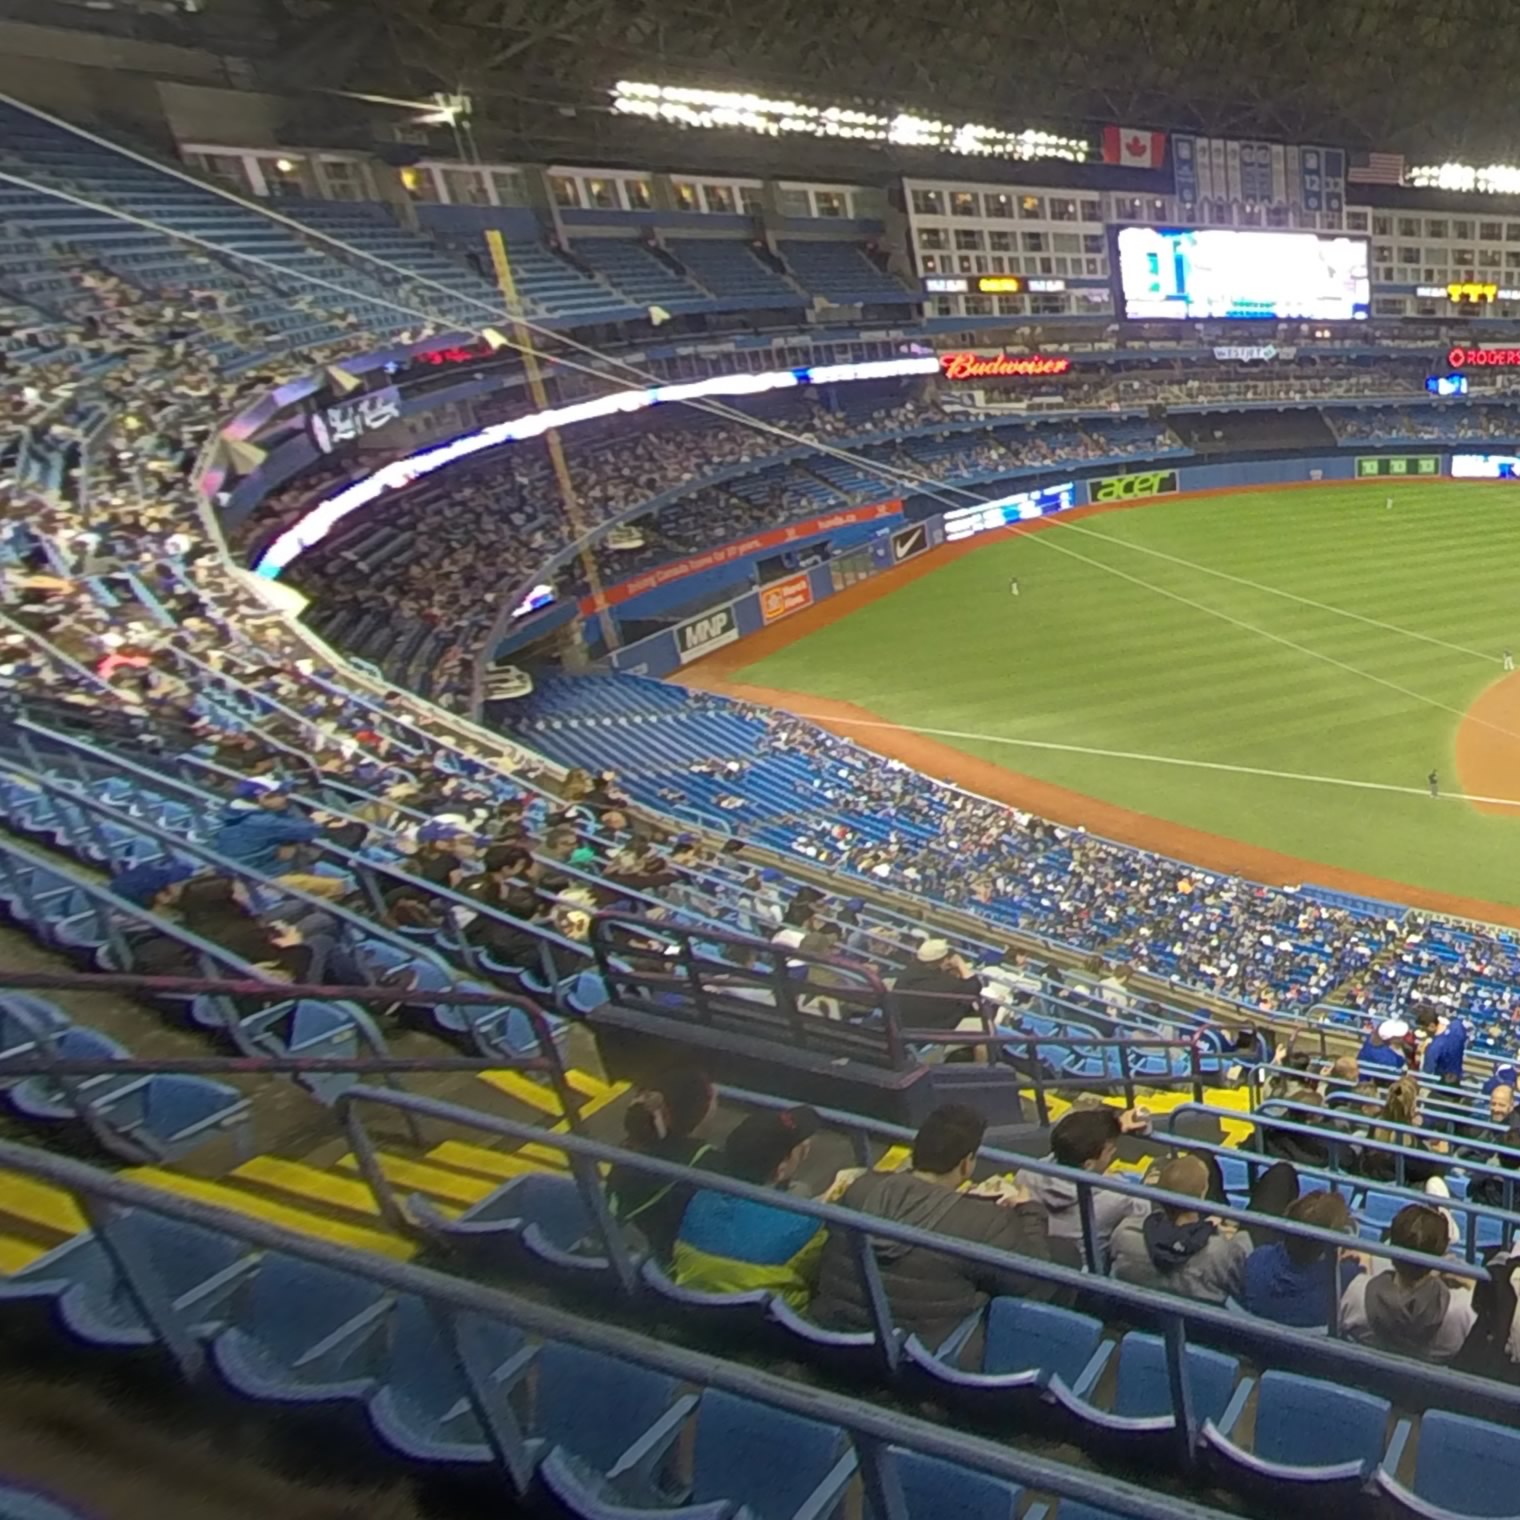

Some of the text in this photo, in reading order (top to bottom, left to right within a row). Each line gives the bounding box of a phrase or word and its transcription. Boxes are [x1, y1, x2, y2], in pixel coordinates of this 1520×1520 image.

[1304, 175, 1320, 191] 12
[940, 352, 1069, 379] Budweiser
[1097, 472, 1169, 501] acer
[685, 612, 728, 649] MNP
